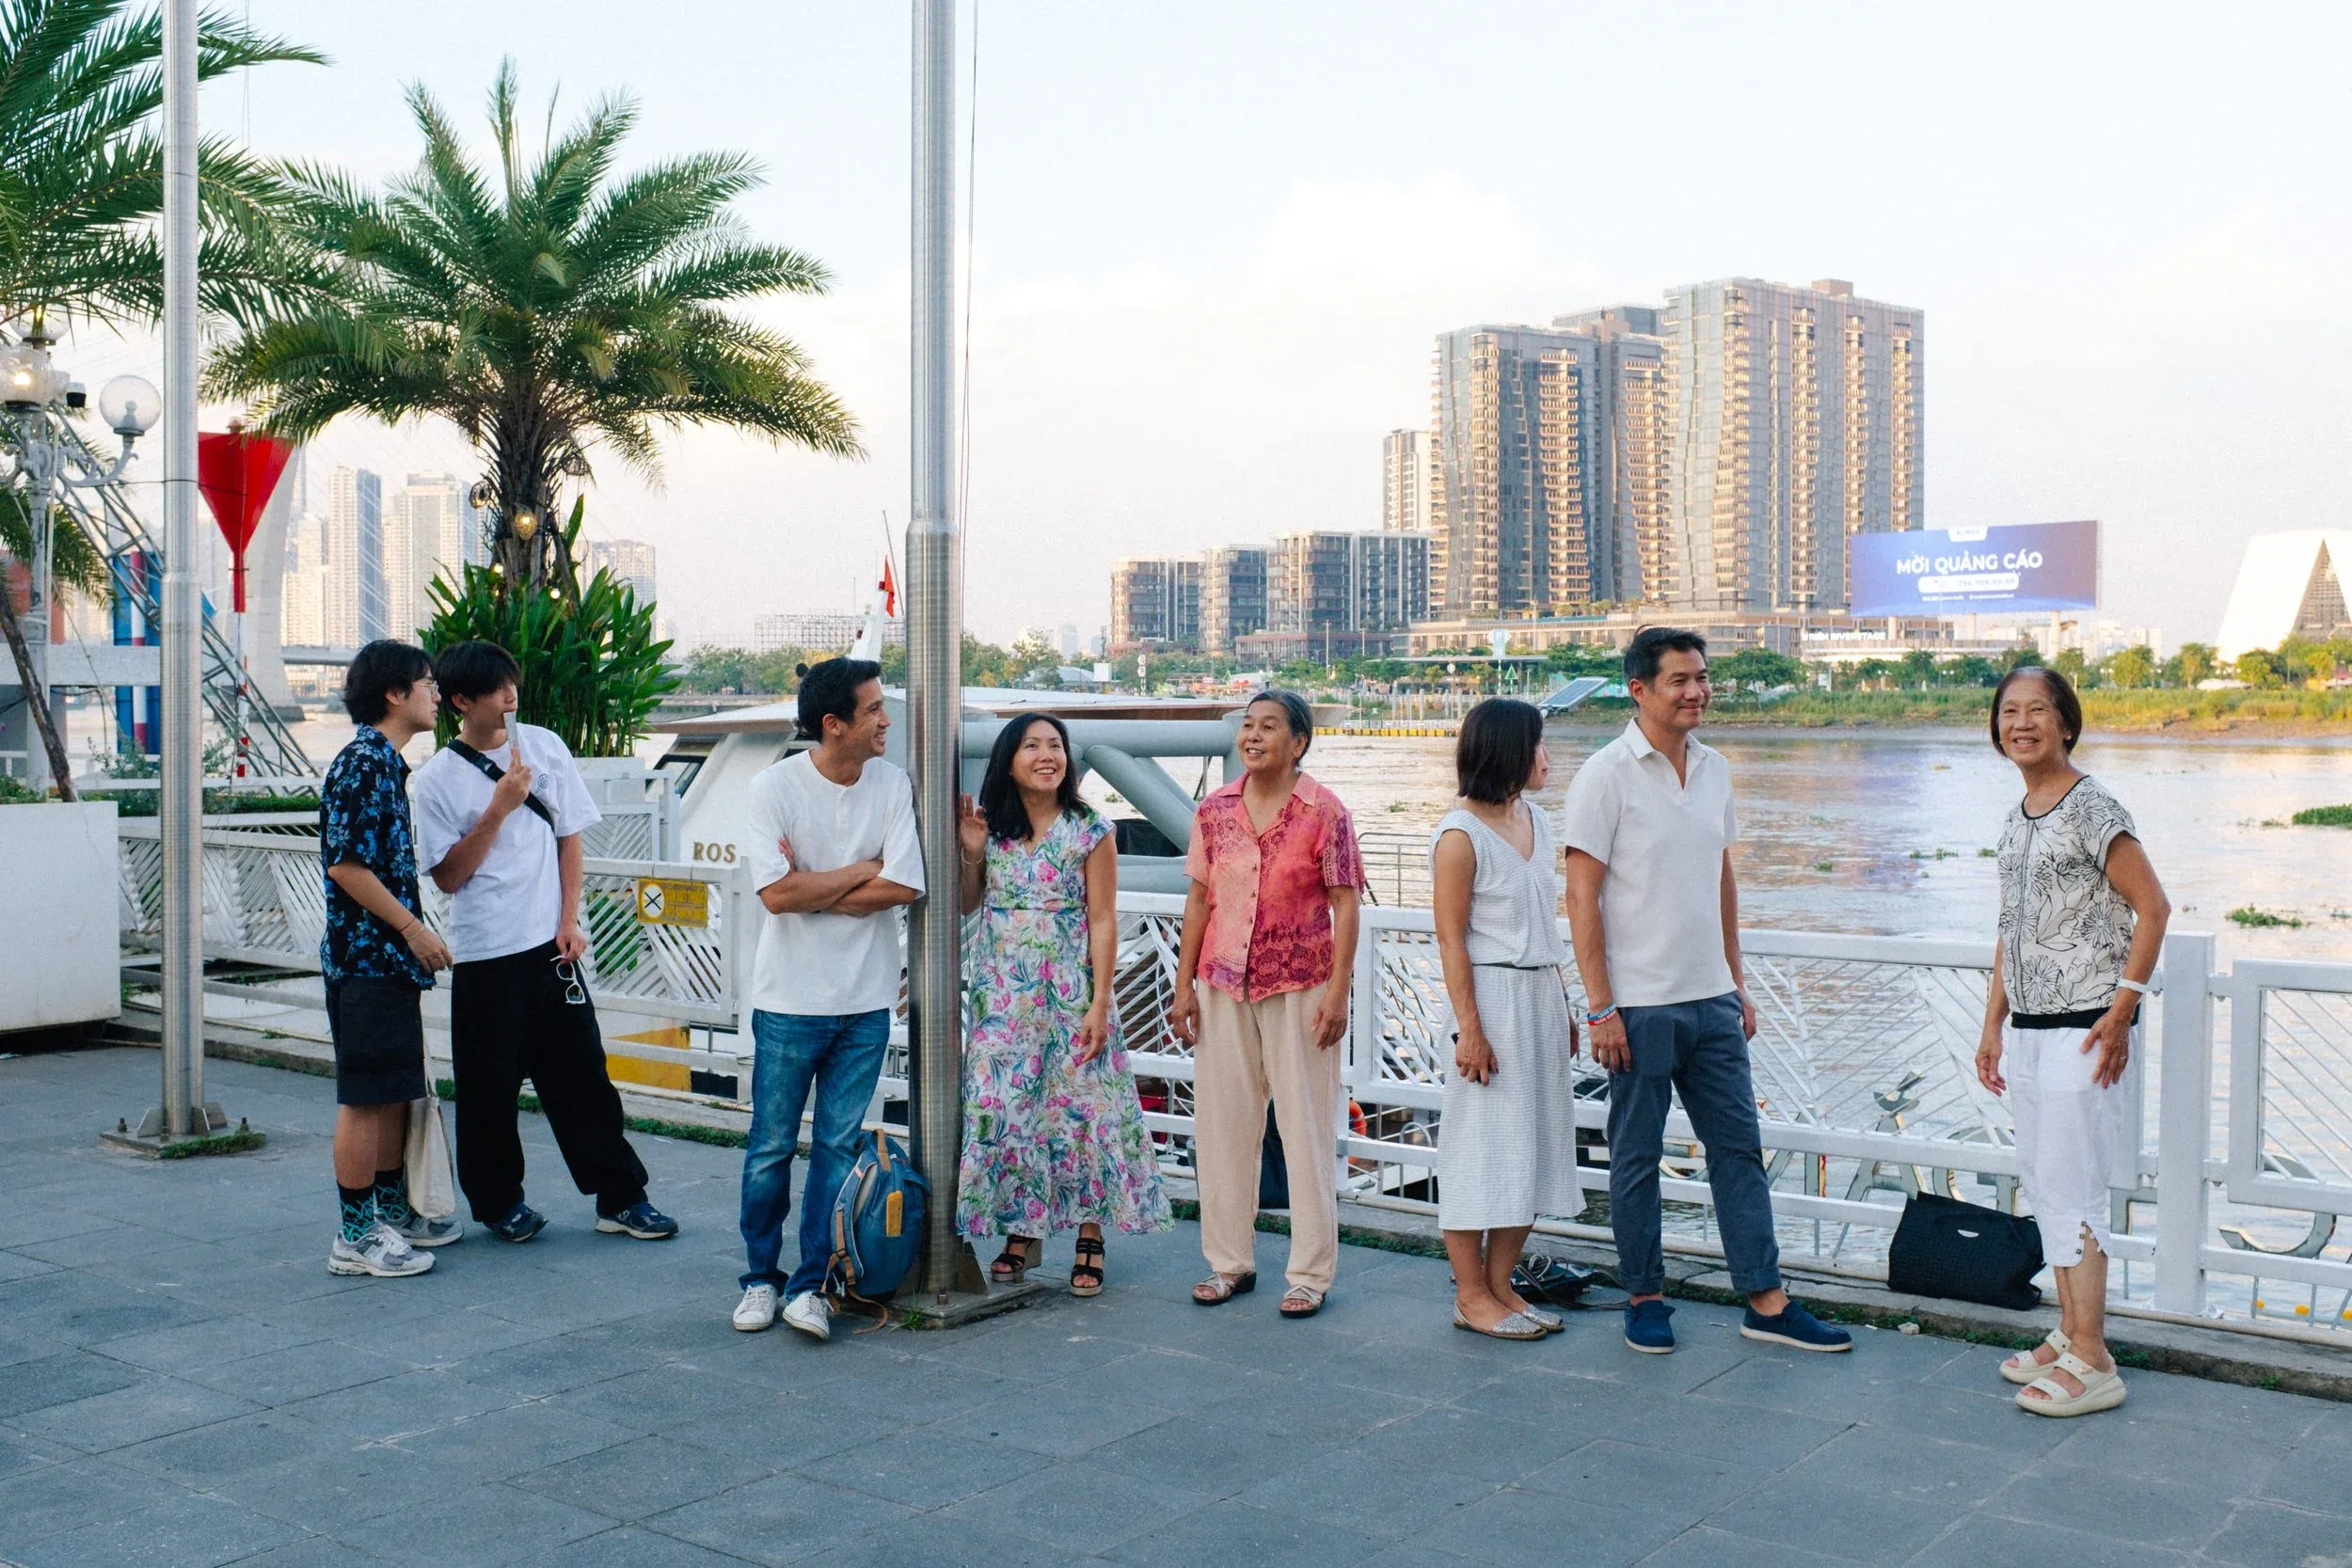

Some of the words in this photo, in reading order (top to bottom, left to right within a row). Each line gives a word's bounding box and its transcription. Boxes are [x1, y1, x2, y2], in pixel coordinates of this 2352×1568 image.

[1897, 554, 1929, 575] MỜI
[1934, 550, 1998, 575] QUẢNG
[2003, 548, 2042, 570] CÁO
[692, 842, 737, 863] ROS
